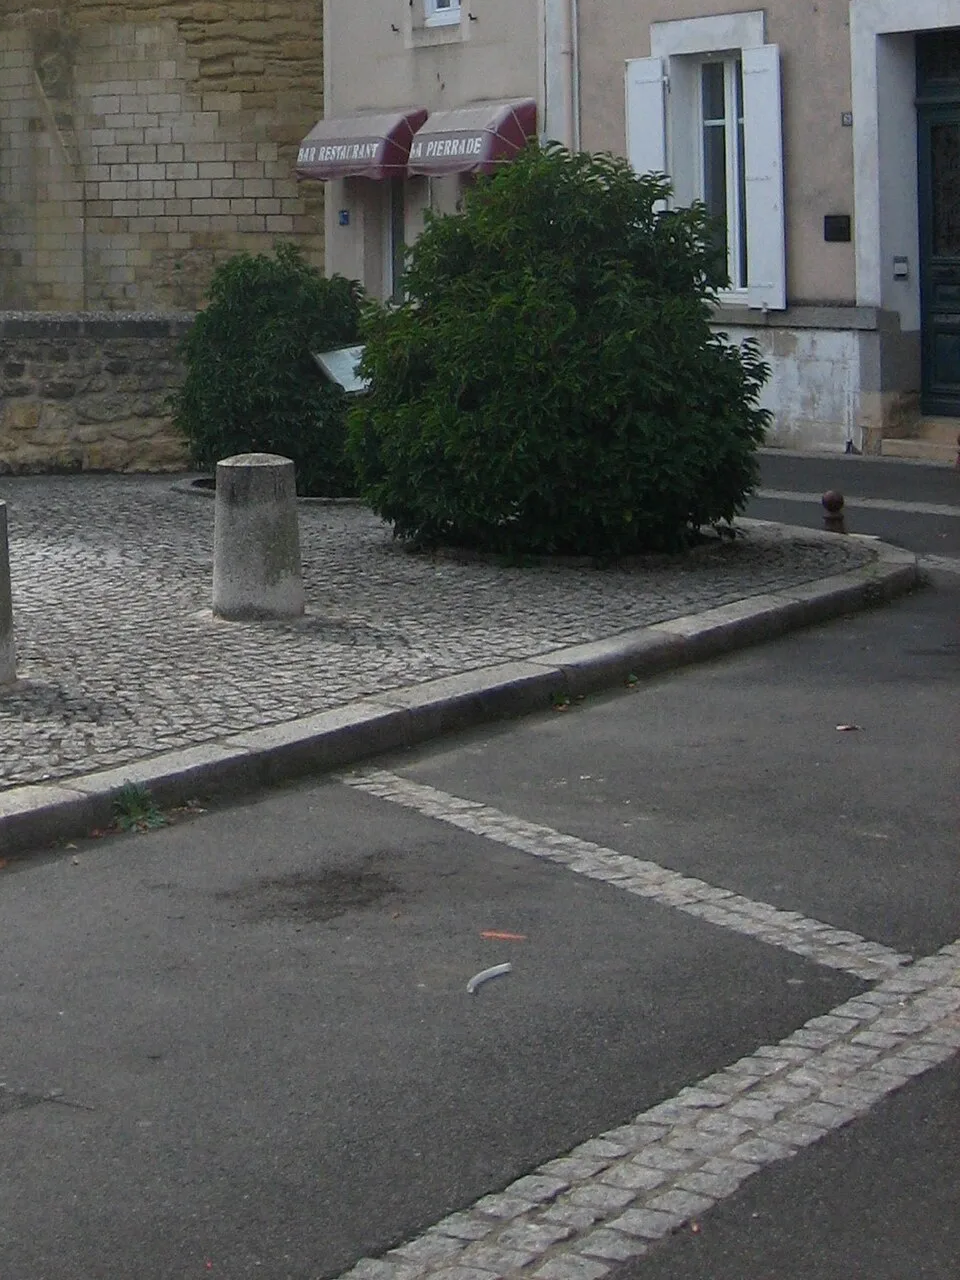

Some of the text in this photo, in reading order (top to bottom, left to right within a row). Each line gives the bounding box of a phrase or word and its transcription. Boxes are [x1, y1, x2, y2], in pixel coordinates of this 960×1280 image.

[297, 143, 379, 162] BAR RESTAURANT
[409, 137, 482, 159] LA PIERRADE
